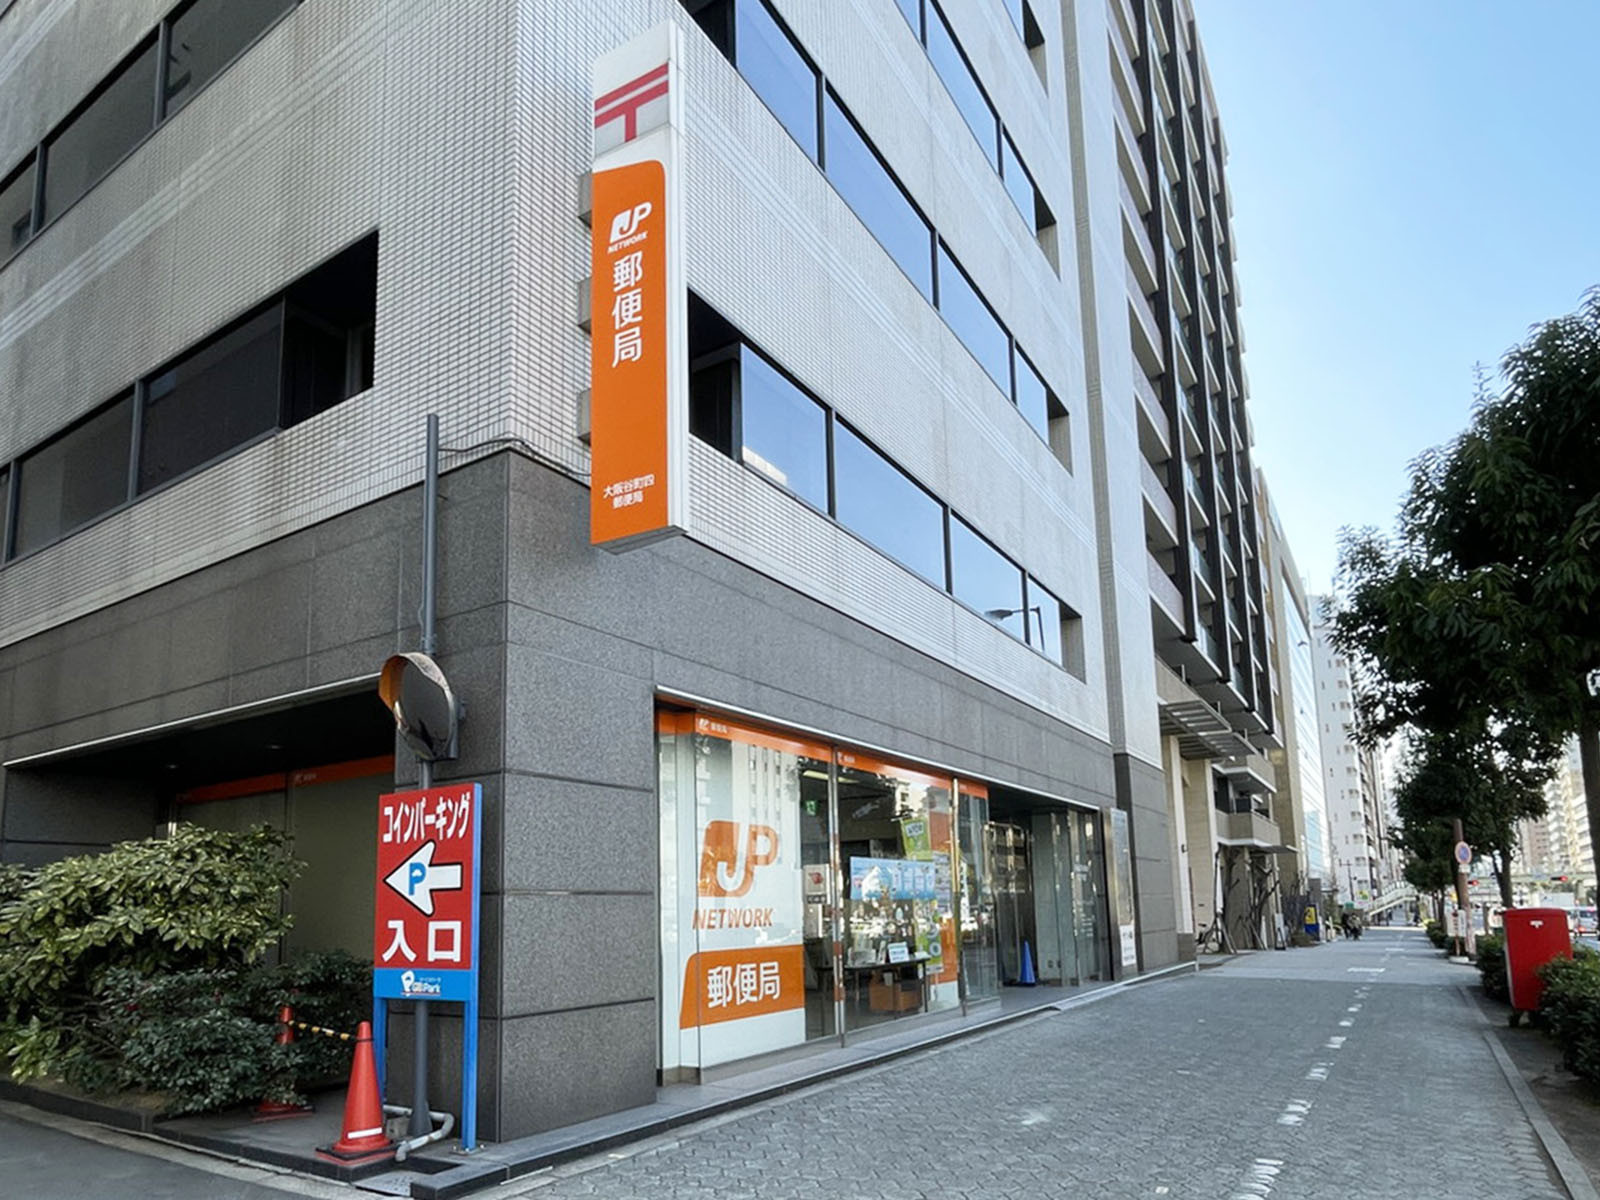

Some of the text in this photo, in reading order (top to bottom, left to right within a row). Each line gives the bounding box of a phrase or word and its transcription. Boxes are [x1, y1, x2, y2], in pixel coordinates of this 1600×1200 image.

[607, 231, 649, 254] NETWORK
[609, 201, 652, 244] JP
[612, 249, 644, 369] 郵便局
[382, 792, 470, 843] コインパーキング
[408, 862, 427, 896] P
[698, 820, 779, 898] JP
[381, 919, 462, 963] 入口
[692, 908, 774, 930] NETWORK
[707, 961, 781, 1009] 郵便局
